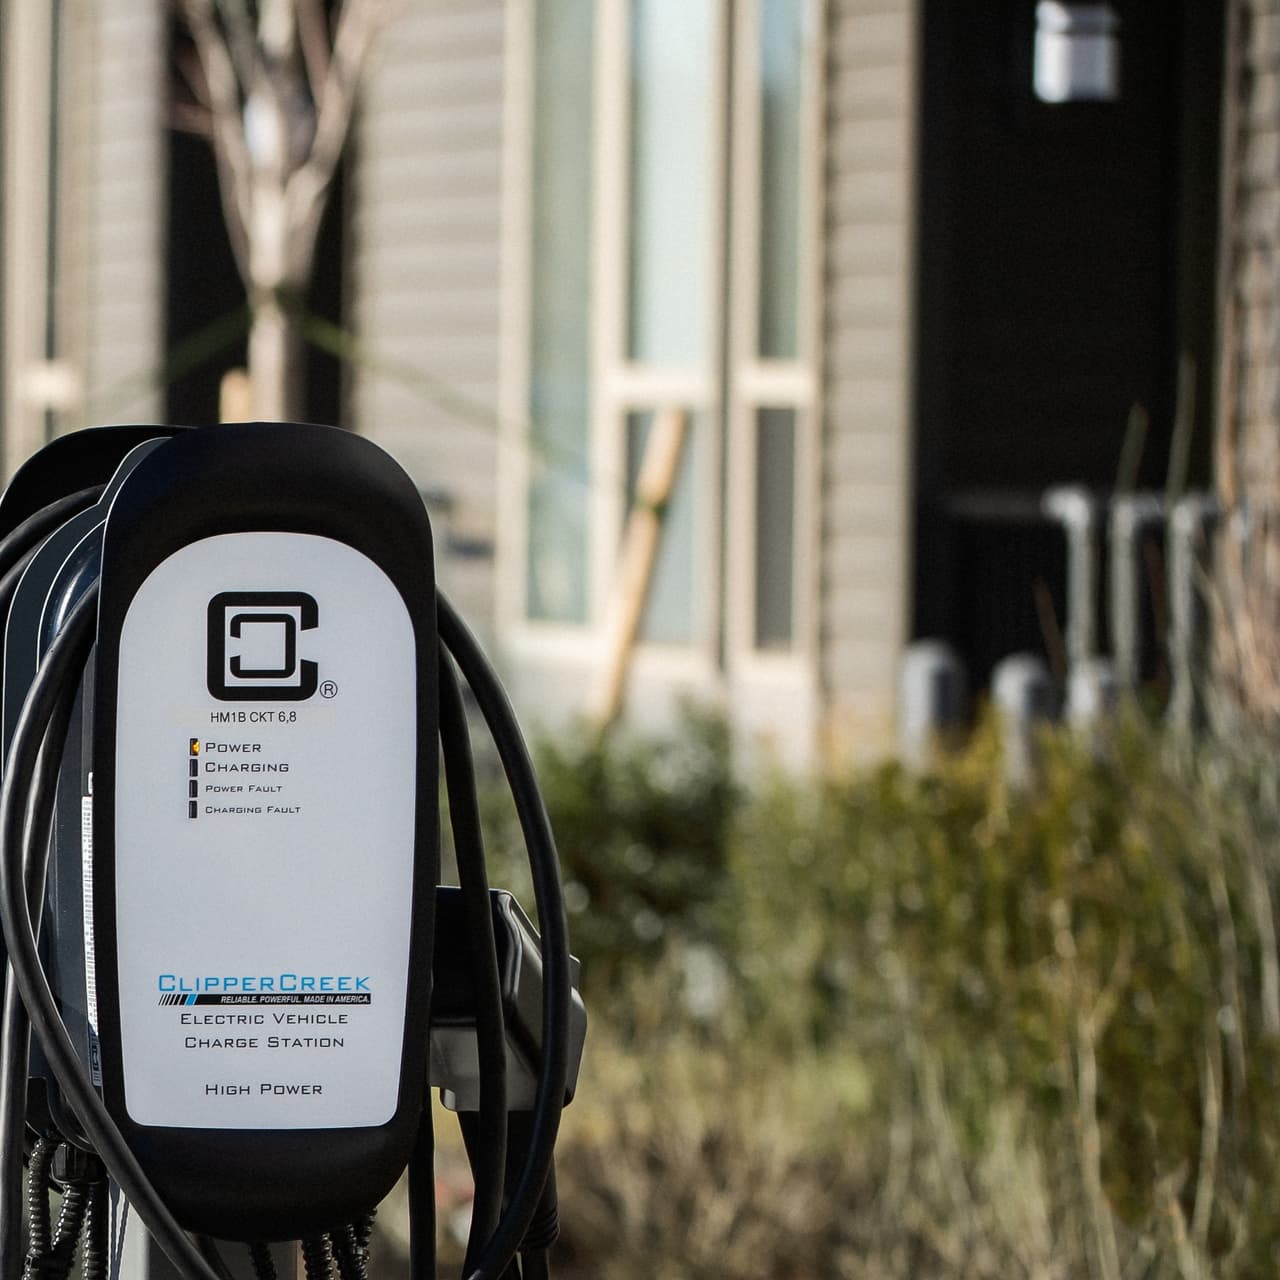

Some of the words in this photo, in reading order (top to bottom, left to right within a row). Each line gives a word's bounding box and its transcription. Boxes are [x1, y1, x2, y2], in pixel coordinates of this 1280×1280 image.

[210, 711, 247, 723] HM1B
[249, 711, 275, 723] CKT
[303, 995, 325, 1003] MADE
[326, 995, 335, 1003] IN
